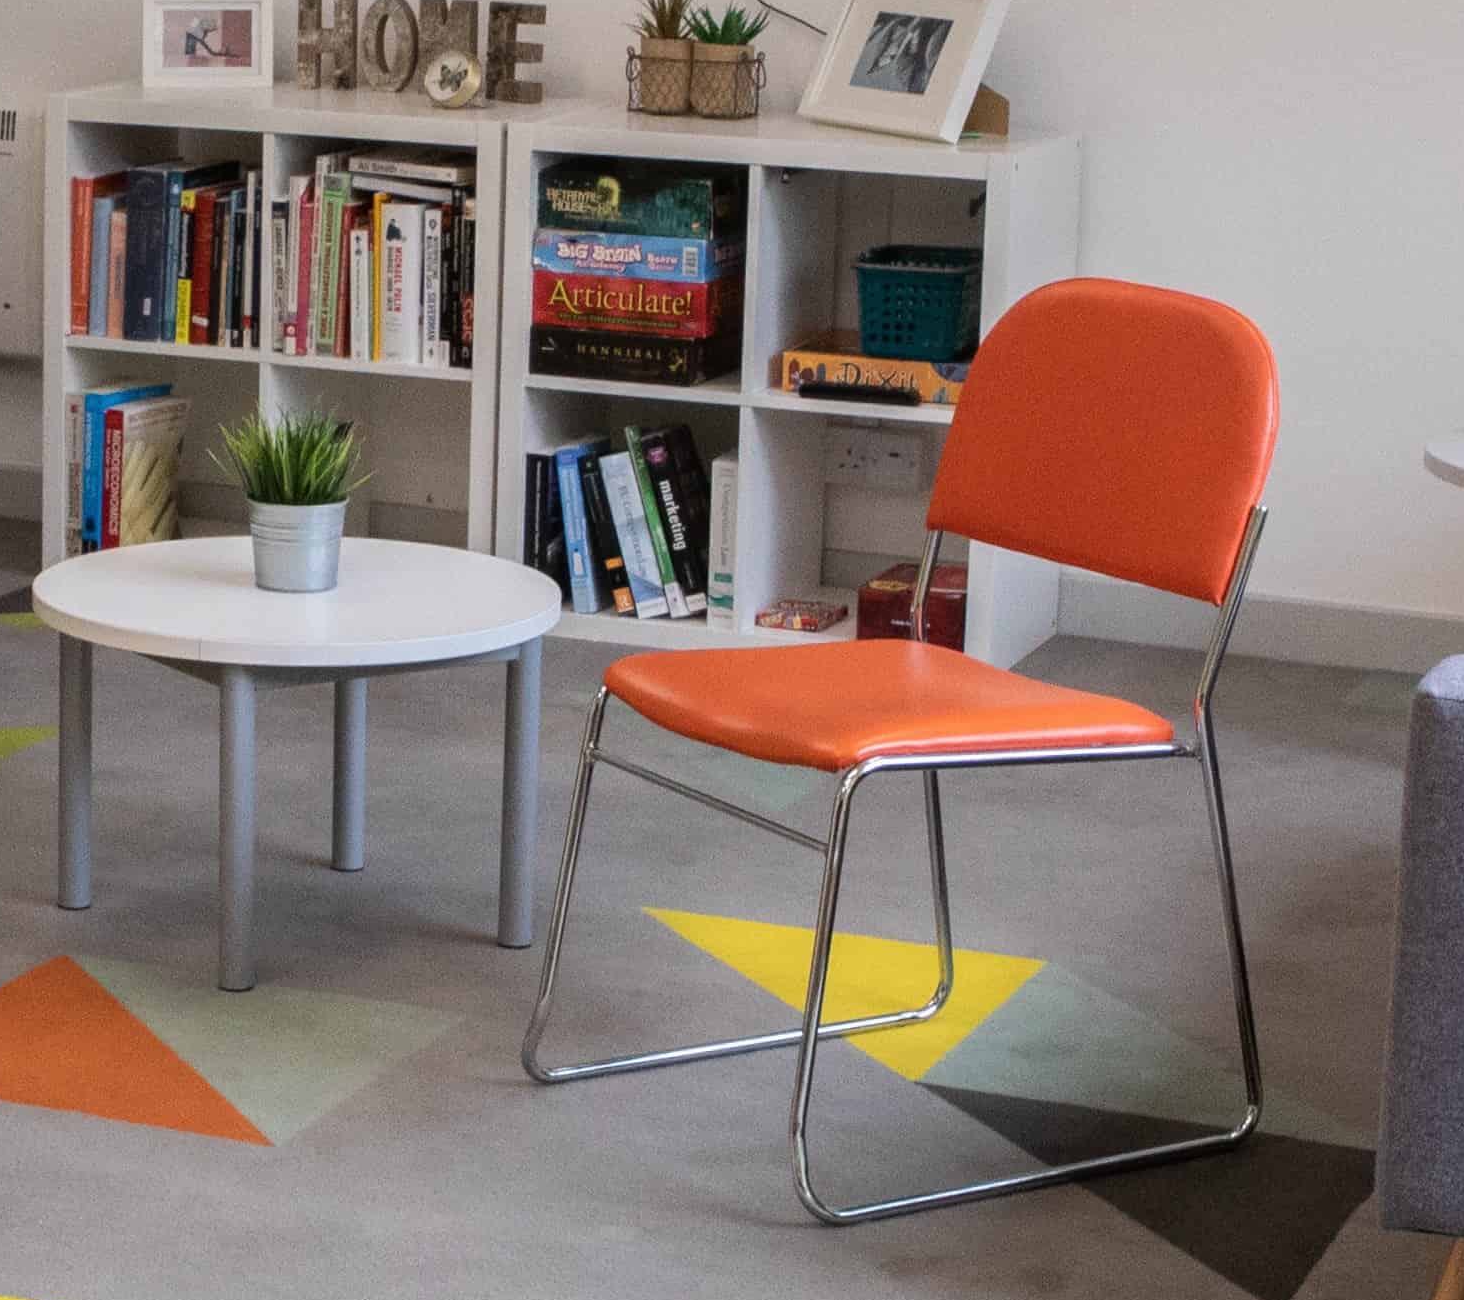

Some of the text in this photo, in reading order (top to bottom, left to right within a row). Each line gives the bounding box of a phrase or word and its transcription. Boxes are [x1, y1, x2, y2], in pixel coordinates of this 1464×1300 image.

[557, 242, 589, 259] BIG
[547, 277, 692, 316] Articulate!
[108, 429, 122, 537] MICROECONOMICS
[659, 480, 687, 551] marketing
